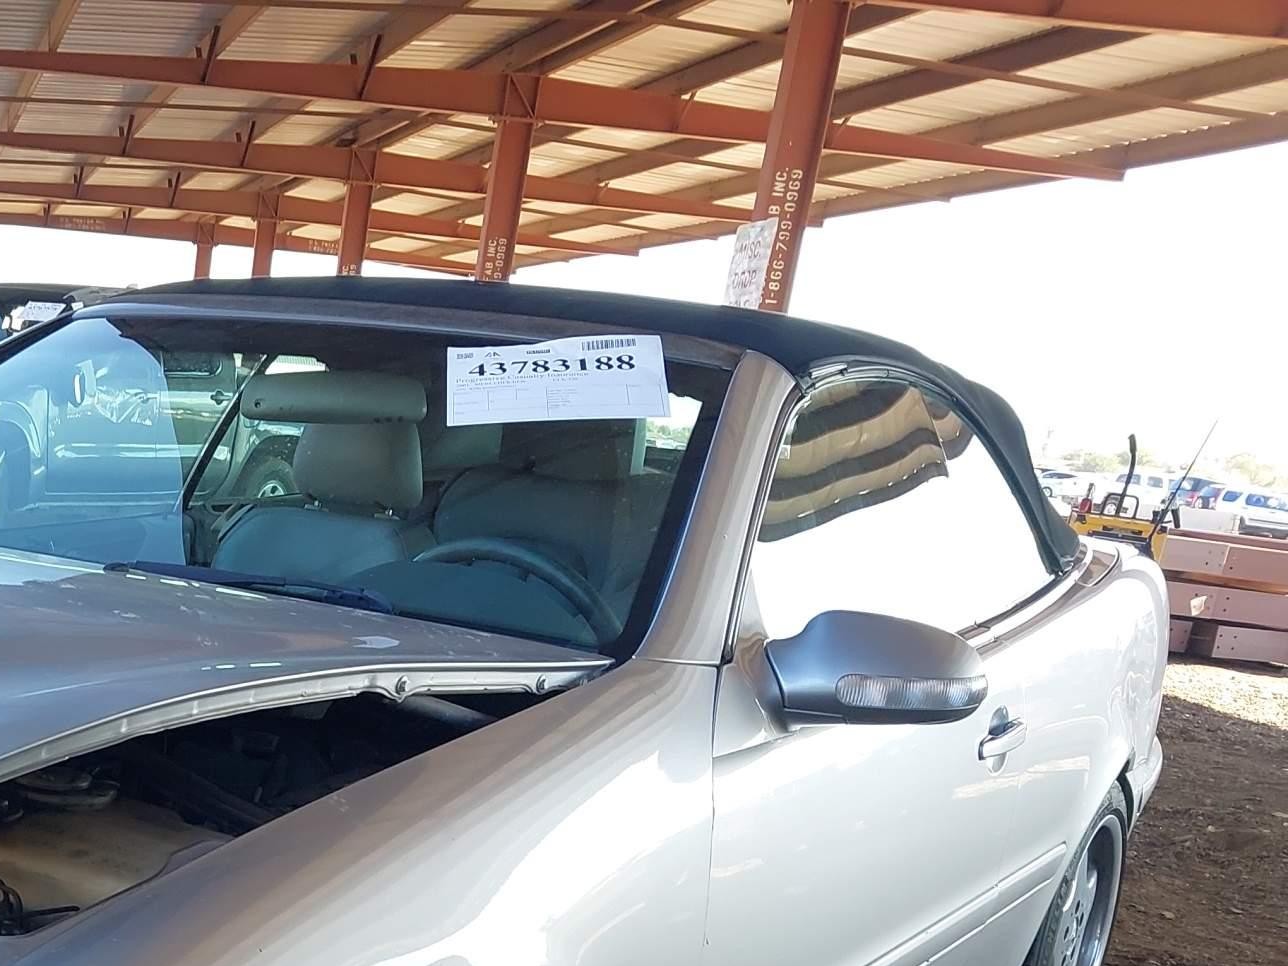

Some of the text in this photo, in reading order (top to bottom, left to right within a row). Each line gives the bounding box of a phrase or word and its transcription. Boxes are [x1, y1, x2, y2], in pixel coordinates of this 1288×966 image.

[772, 168, 789, 197] INC.
[765, 169, 803, 304] 1-866-799-0969
[468, 355, 636, 376] 43783188
